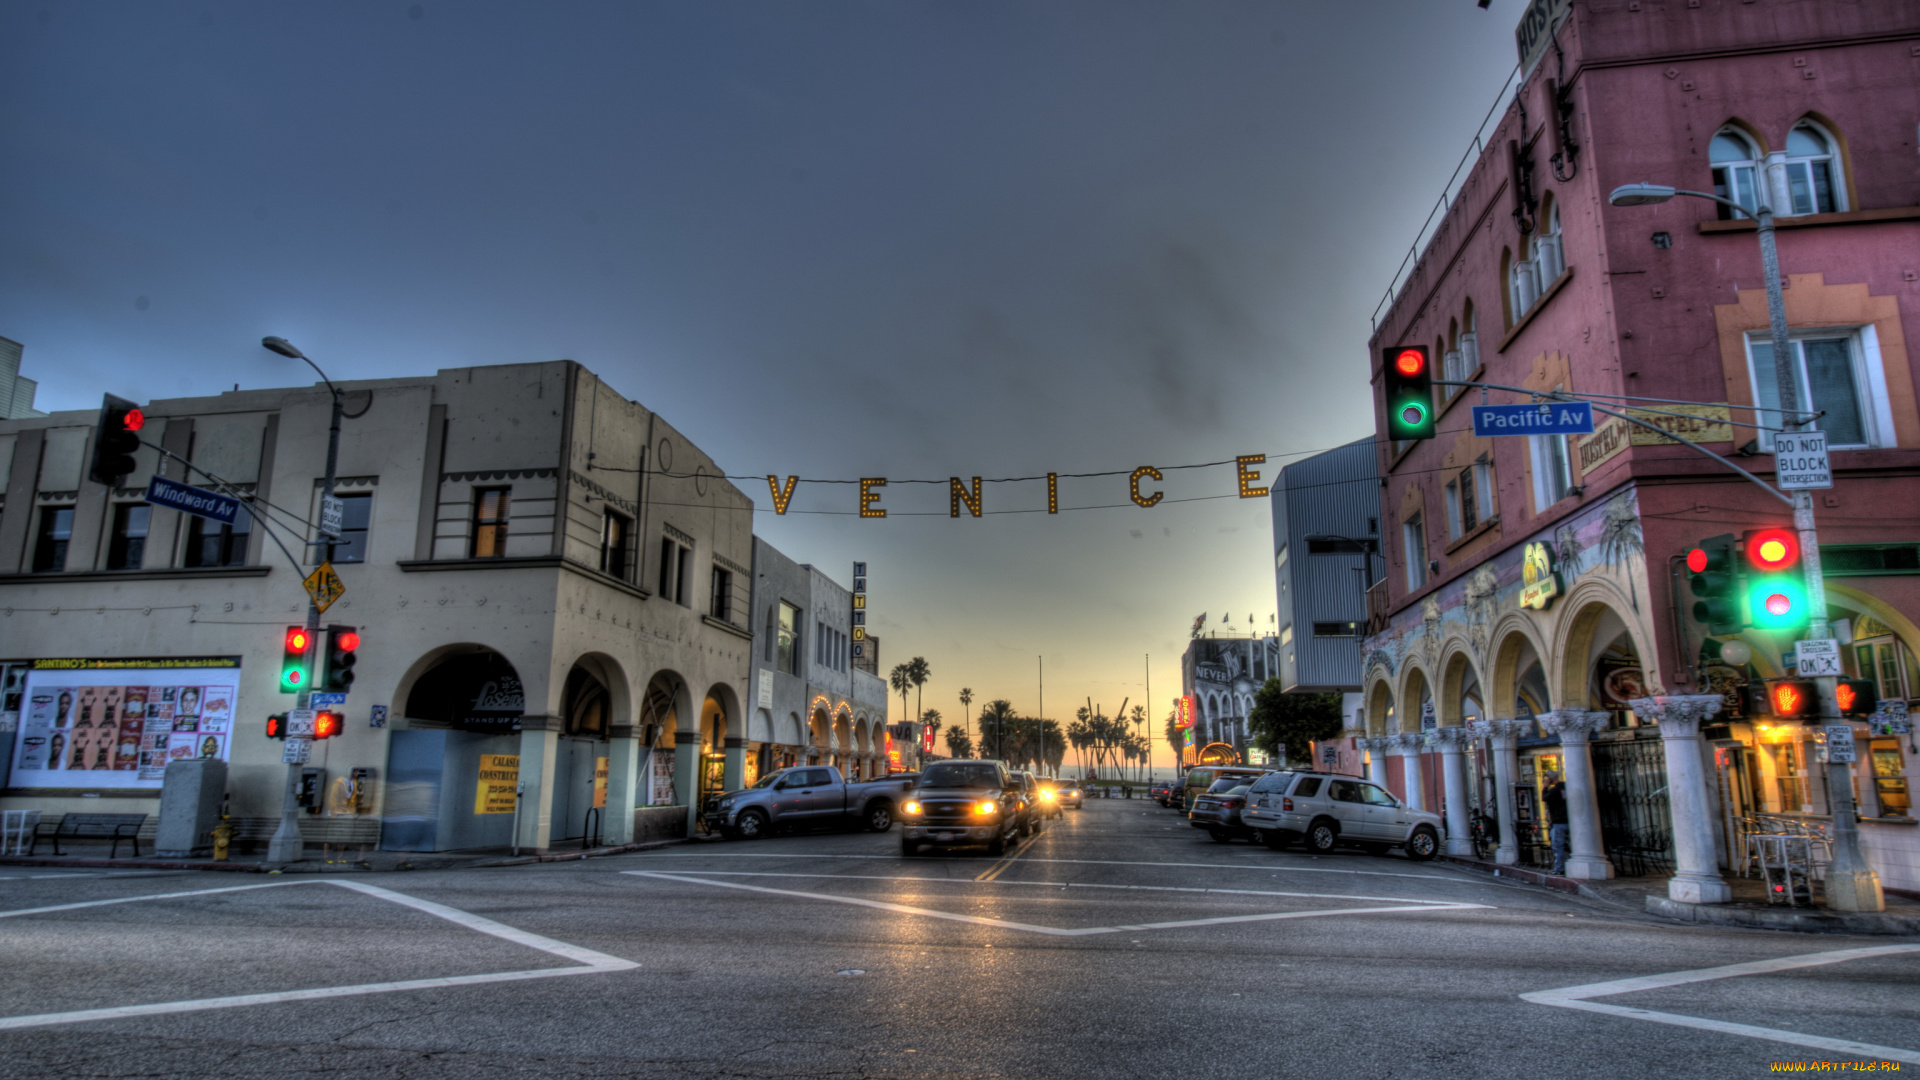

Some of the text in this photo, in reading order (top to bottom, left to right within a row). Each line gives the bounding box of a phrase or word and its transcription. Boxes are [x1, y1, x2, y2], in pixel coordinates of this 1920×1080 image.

[1482, 409, 1584, 428] Pacific Av
[1632, 415, 1700, 435] HOSTEL
[1580, 424, 1618, 470] HOSTEL
[1777, 438, 1824, 453] DO NOT
[1780, 457, 1828, 471] BLOCK
[767, 453, 1269, 518] VENICE
[1782, 473, 1829, 484] INTERSECTION
[153, 482, 234, 517] Windward Av
[854, 563, 865, 657] TATTOO
[34, 659, 87, 669] SANTINO'S
[1801, 659, 1817, 672] OK
[290, 722, 301, 732] OK
